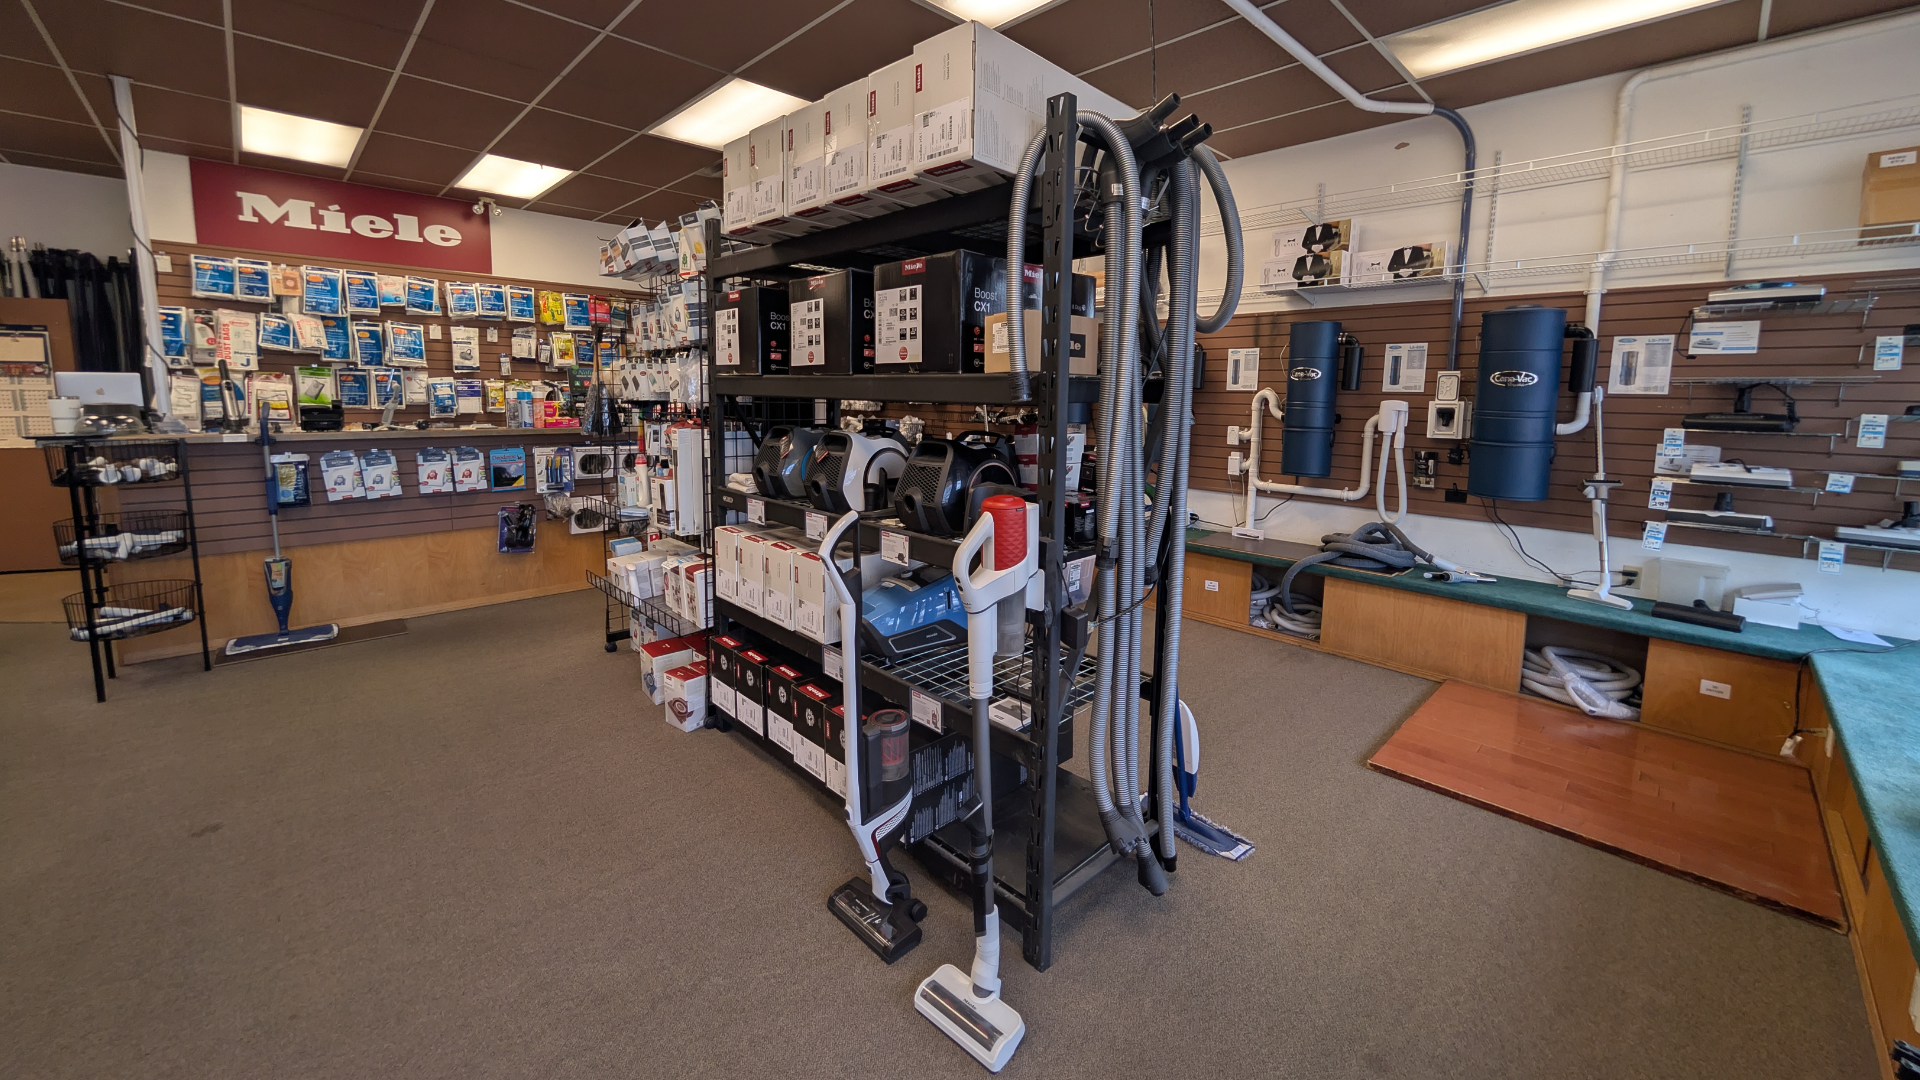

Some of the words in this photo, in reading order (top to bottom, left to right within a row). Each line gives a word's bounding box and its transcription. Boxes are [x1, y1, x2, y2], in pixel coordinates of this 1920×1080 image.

[235, 191, 463, 247] Miele
[905, 262, 923, 271] Miele
[1024, 269, 1041, 279] Mie
[810, 278, 824, 286] Miele
[974, 287, 998, 301] Boost
[974, 301, 991, 312] CX1
[770, 311, 790, 321] Boos
[770, 321, 786, 331] CX1
[222, 323, 231, 341] BAGS
[223, 343, 232, 360] DUST
[240, 358, 251, 367] J
[1494, 371, 1533, 383] Cana-Vac
[806, 685, 825, 698] Miele
[963, 998, 977, 1010] Miele
